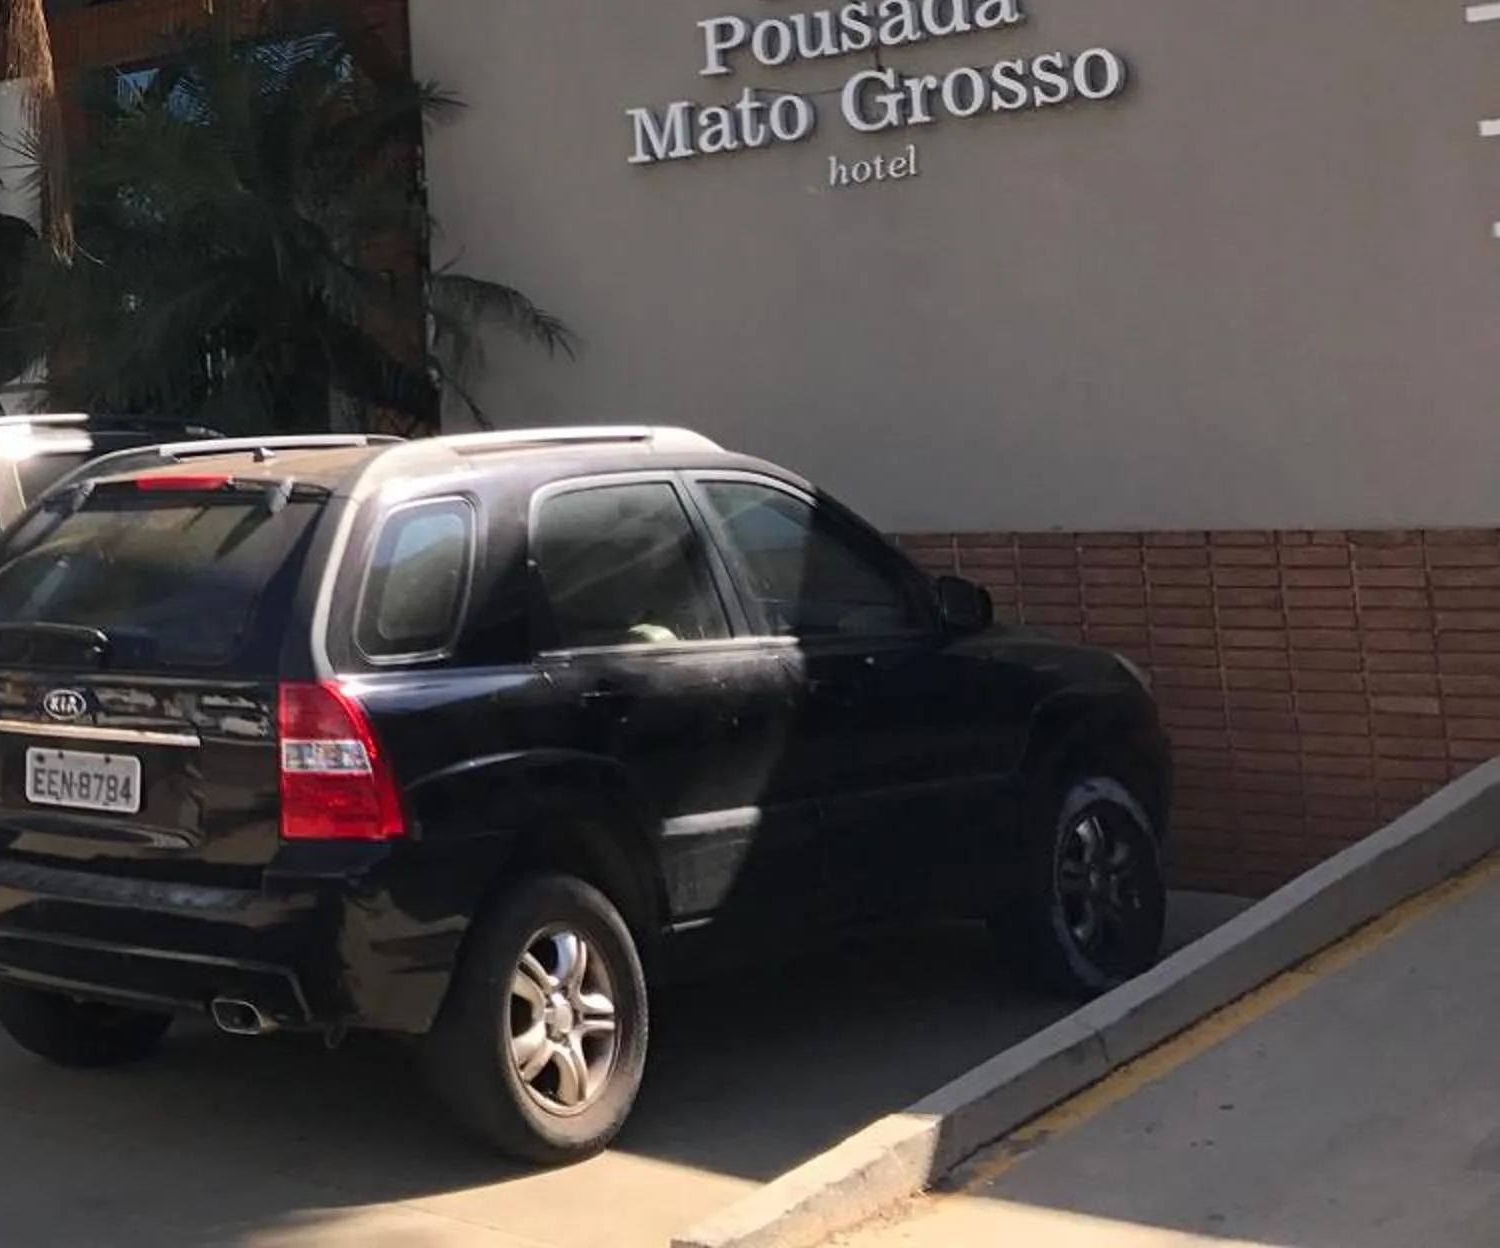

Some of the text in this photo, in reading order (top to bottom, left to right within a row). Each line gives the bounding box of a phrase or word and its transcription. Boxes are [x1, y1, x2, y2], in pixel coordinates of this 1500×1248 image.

[625, 47, 1122, 165] Mato Grosso
[828, 144, 918, 186] hotel
